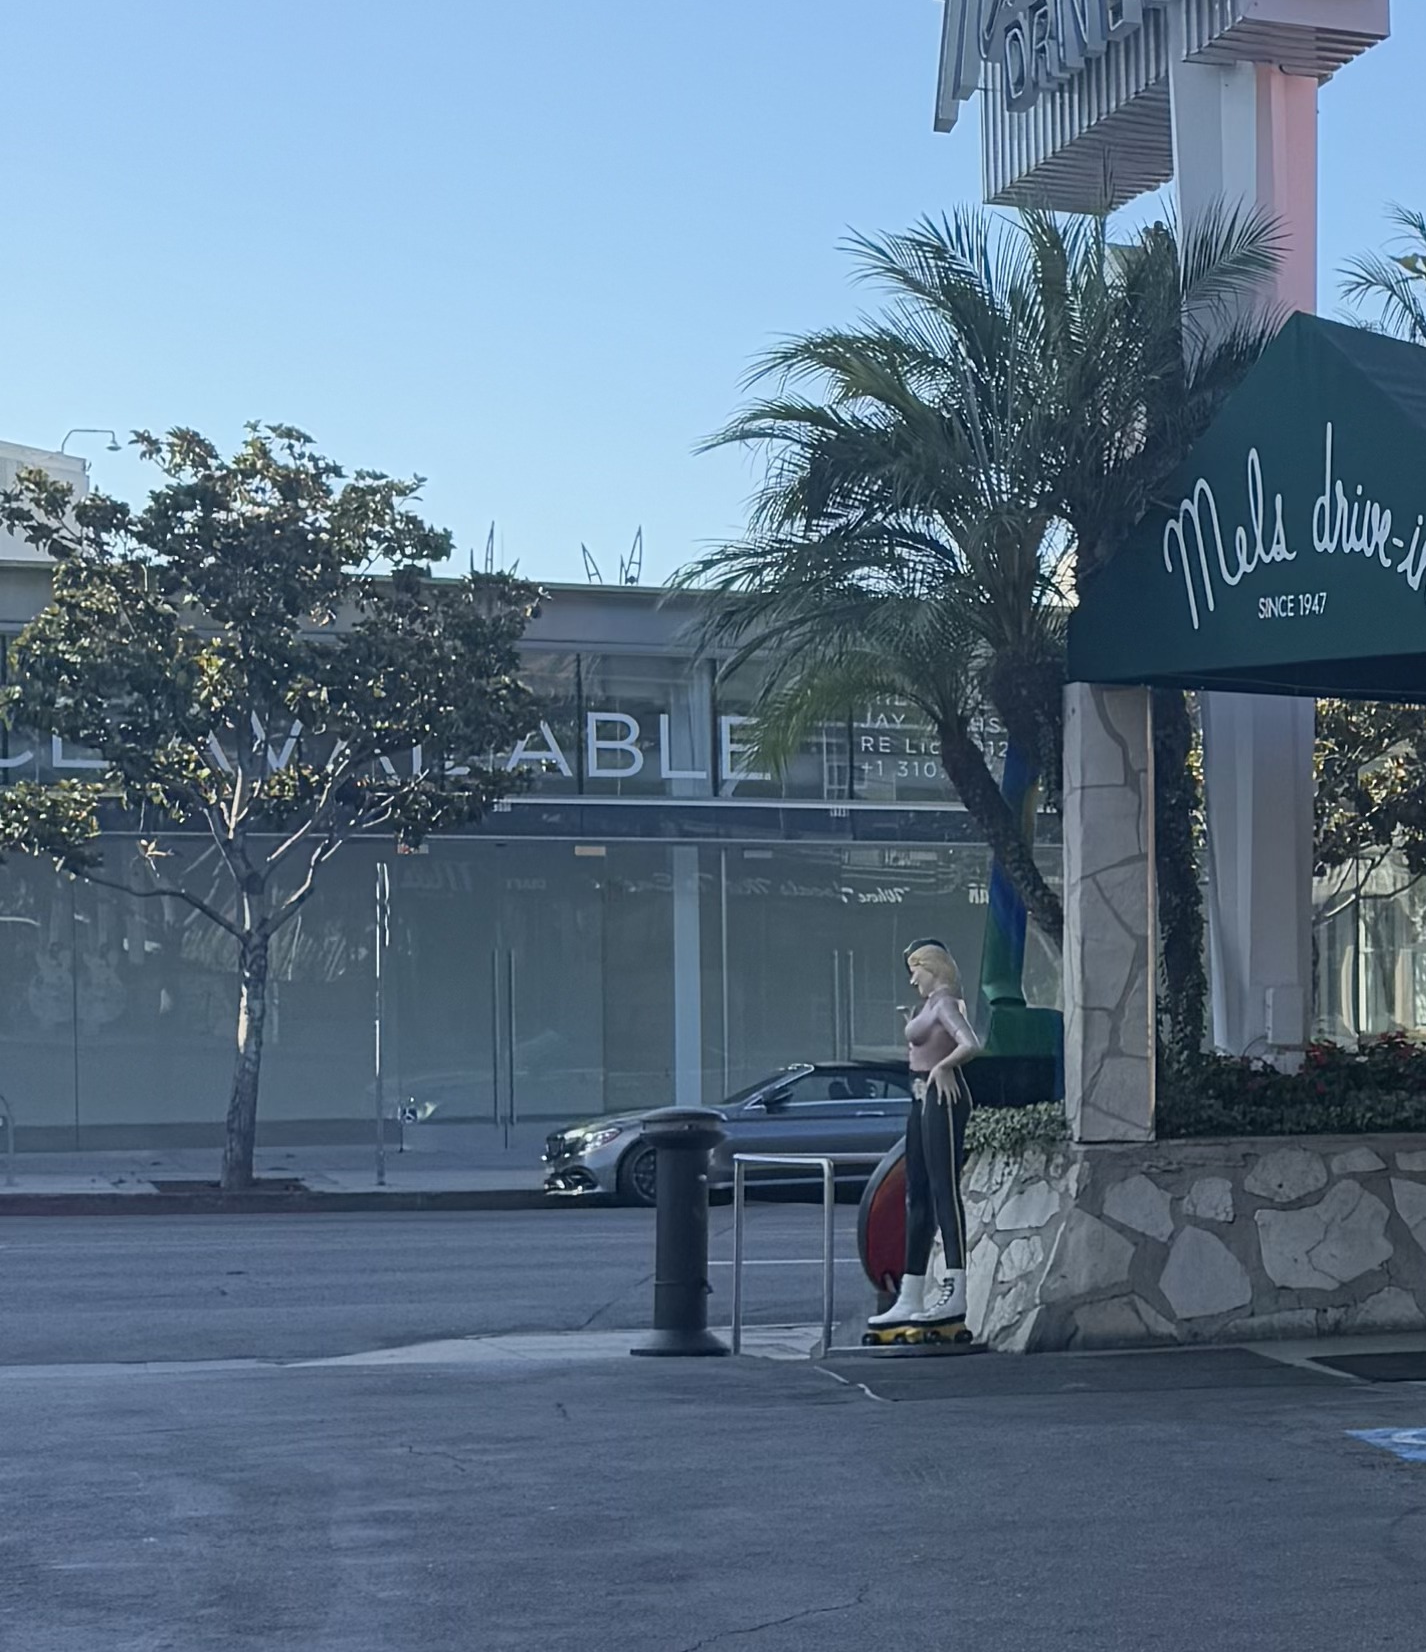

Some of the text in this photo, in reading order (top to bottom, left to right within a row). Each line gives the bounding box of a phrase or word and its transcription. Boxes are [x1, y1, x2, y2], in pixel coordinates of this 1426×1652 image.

[1163, 447, 1297, 630] Mels
[1258, 592, 1327, 619] SINCE 1947
[861, 736, 892, 754] RE
